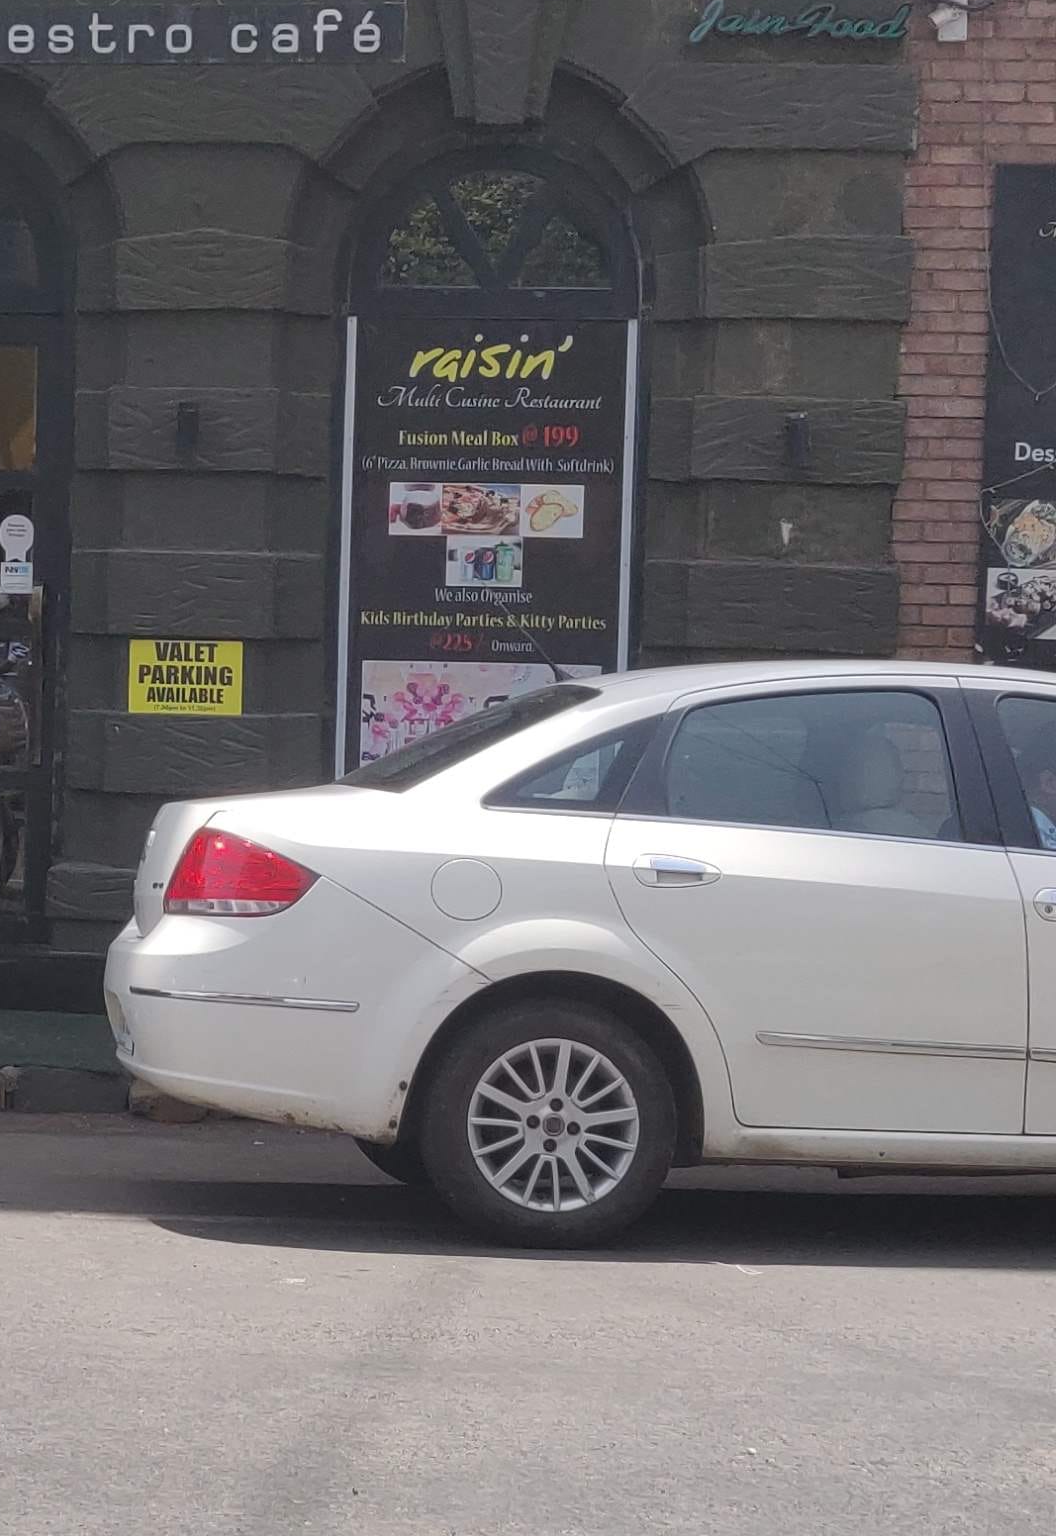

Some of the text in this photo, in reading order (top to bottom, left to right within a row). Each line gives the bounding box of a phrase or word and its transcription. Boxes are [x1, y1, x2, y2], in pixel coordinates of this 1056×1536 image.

[689, 0, 786, 42] Jain
[231, 9, 381, 54] café
[377, 384, 442, 408] Multi
[505, 387, 602, 409] Restaurant
[399, 430, 448, 446] Fusion
[452, 430, 488, 447] Meal
[493, 431, 518, 446] Box
[543, 425, 581, 447] 199
[1015, 442, 1056, 462] Des
[492, 457, 522, 471] Bread
[525, 458, 552, 472] With
[435, 588, 533, 606] We also Organise
[361, 611, 606, 631] Kids Birthday Parties & Kitty Parties
[155, 642, 218, 662] VALET
[138, 665, 232, 686] PARKING
[147, 687, 224, 704] AVAILABLE
